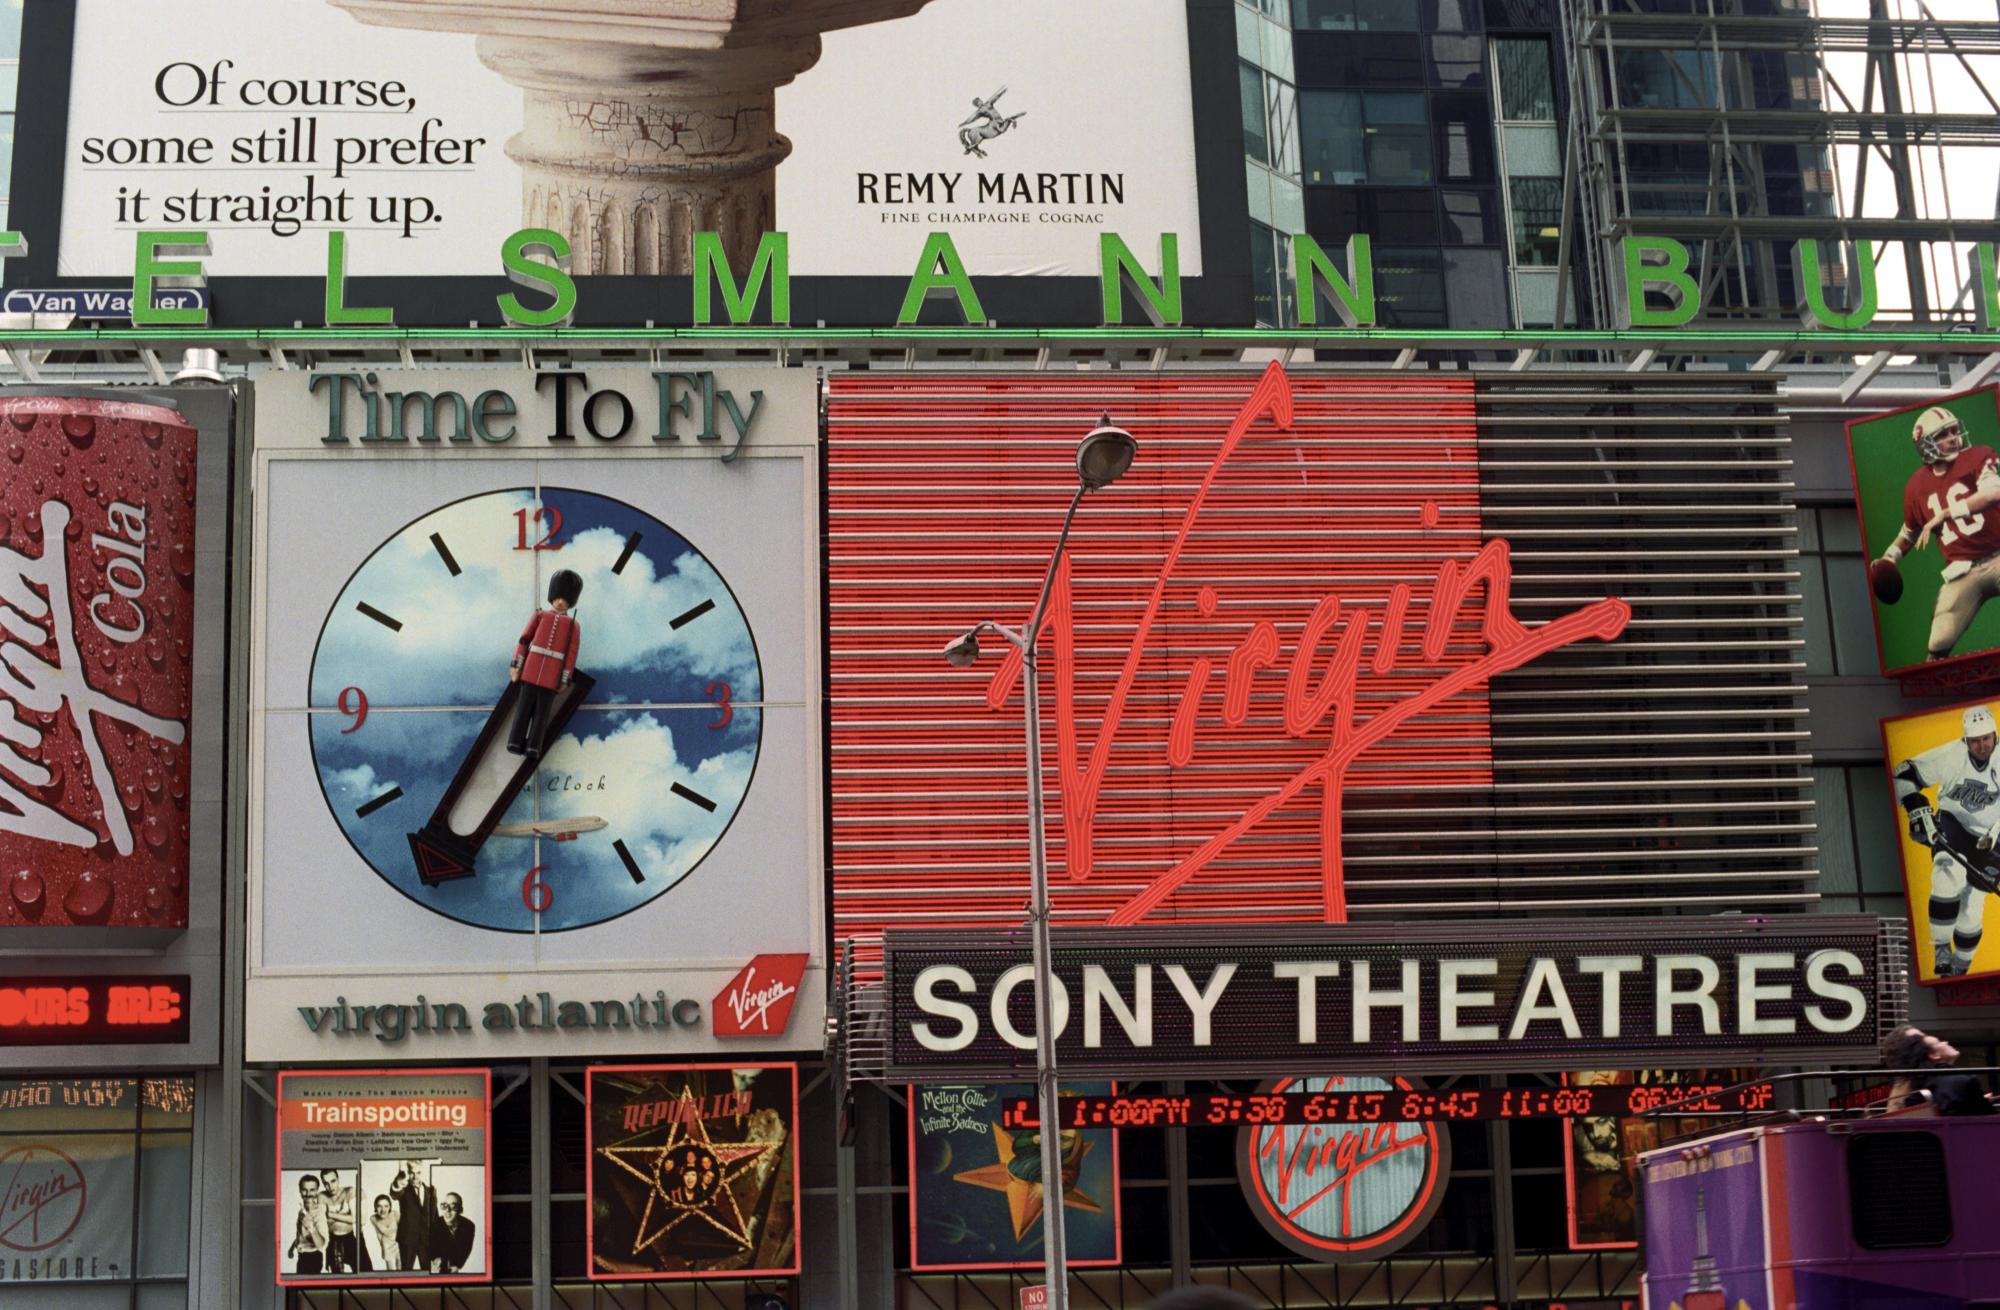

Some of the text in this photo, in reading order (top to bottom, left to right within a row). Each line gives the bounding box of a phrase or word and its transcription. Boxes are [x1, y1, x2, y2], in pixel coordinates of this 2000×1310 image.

[155, 59, 416, 113] Of course,
[82, 117, 486, 178] some still prefer
[115, 175, 443, 238] it straight up.
[857, 173, 1124, 204] REMY MARTIN
[881, 212, 1104, 223] FINE CHAMPAGNE COGNAC
[28, 293, 76, 311] Van
[309, 370, 763, 463] Time To Fly
[513, 506, 564, 551] 12
[90, 500, 146, 643] Cola
[988, 361, 1630, 924] Virgin
[338, 687, 368, 734] 9
[706, 682, 733, 730] 3
[547, 774, 606, 792] Clock
[522, 864, 553, 912] 6
[107, 986, 181, 1024] ARE:
[298, 990, 702, 1042] virgin atlantic
[728, 966, 795, 1030] Virgin
[910, 948, 1867, 1052] SONY THEATRES
[302, 1101, 468, 1128] Trainspotting
[624, 1090, 752, 1133] REPUBLICA
[922, 1088, 988, 1112] Mellon Collie
[942, 1104, 966, 1113] and the
[1073, 1099, 1190, 1126] 1:00PM
[1207, 1097, 1287, 1123] 3:30
[1304, 1095, 1384, 1121] 6:15
[1500, 1090, 1592, 1117] 11:00
[1739, 1085, 1772, 1110] OF
[920, 1117, 951, 1135] Infinite
[948, 1113, 988, 1134] Sadness
[1261, 1075, 1427, 1236] Virgin
[1028, 1290, 1044, 1303] NO
